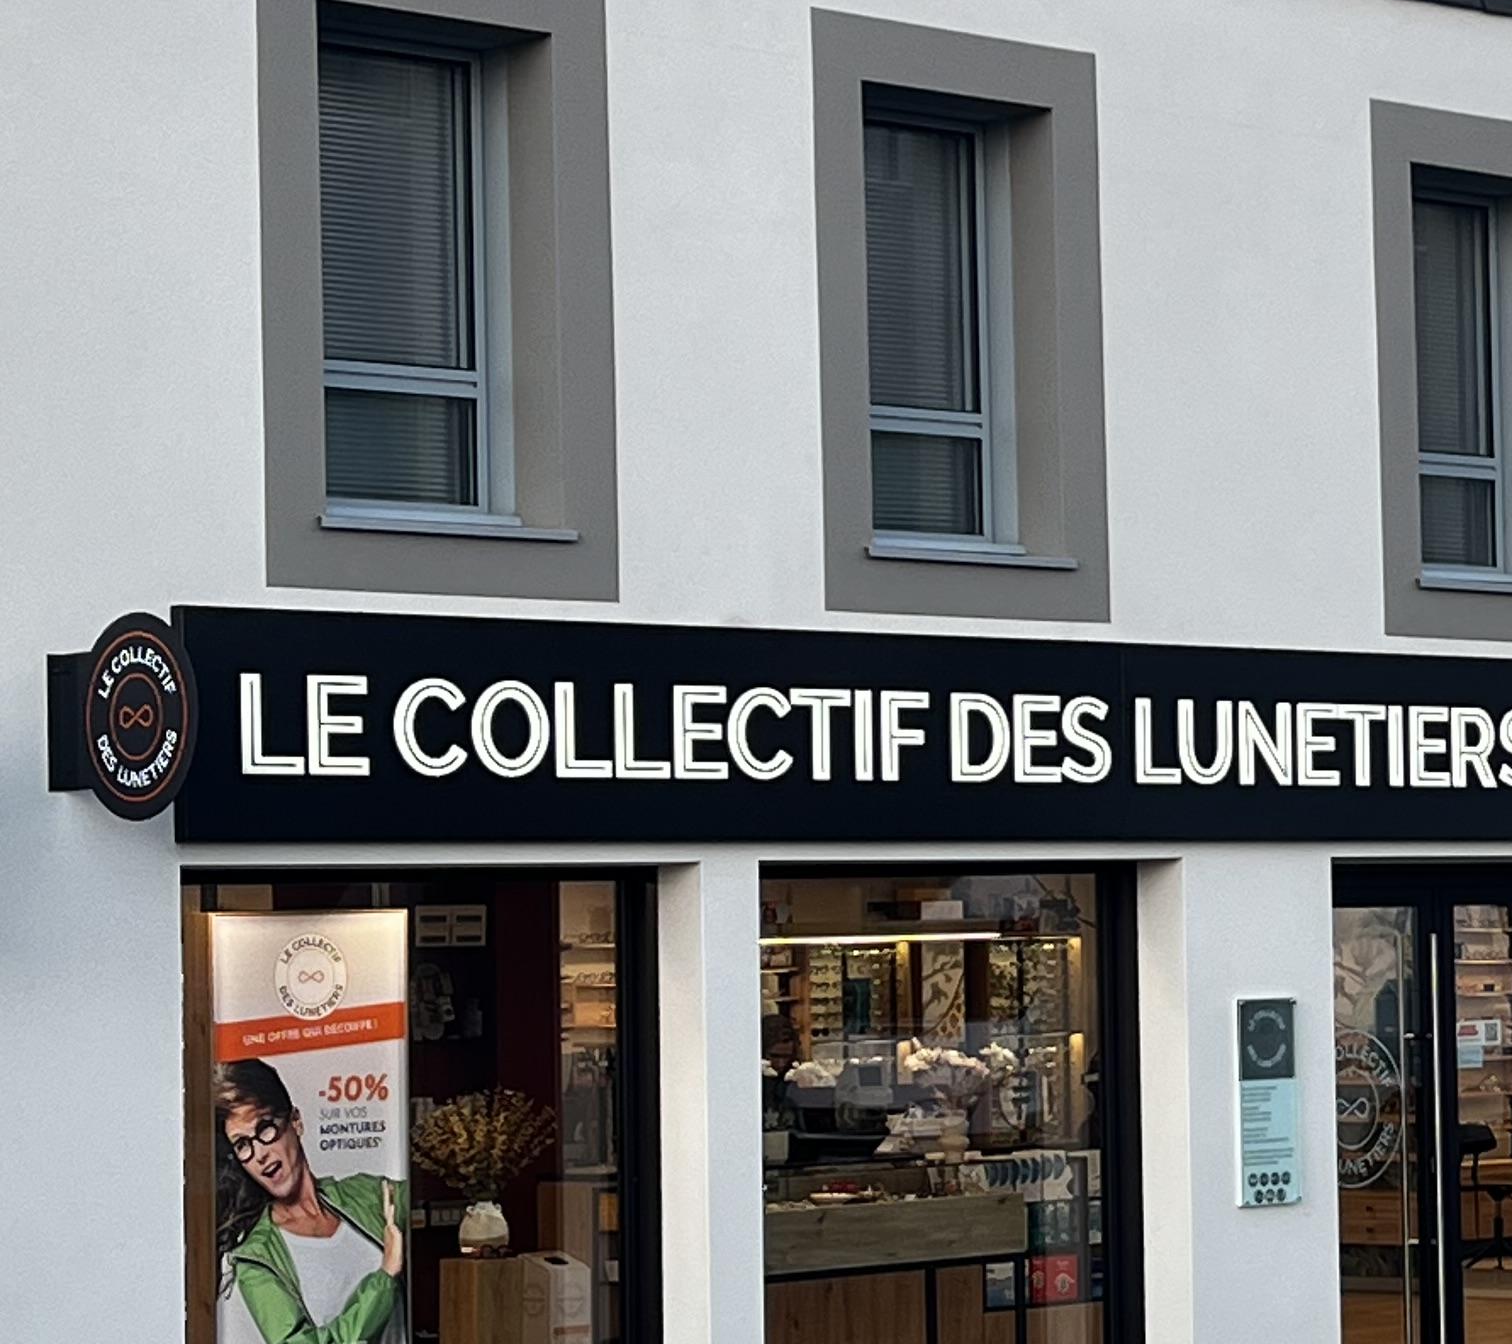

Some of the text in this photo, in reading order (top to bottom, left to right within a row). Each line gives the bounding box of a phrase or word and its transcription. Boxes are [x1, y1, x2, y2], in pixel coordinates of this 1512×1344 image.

[98, 646, 177, 699] LE COLLECTIF
[239, 672, 371, 776] LE
[393, 677, 930, 782] COLLECTIF
[949, 691, 1112, 784] DES
[97, 729, 178, 787] DES LUNETIERS
[319, 1073, 389, 1102] -50%
[320, 1120, 386, 1134] MONTURES
